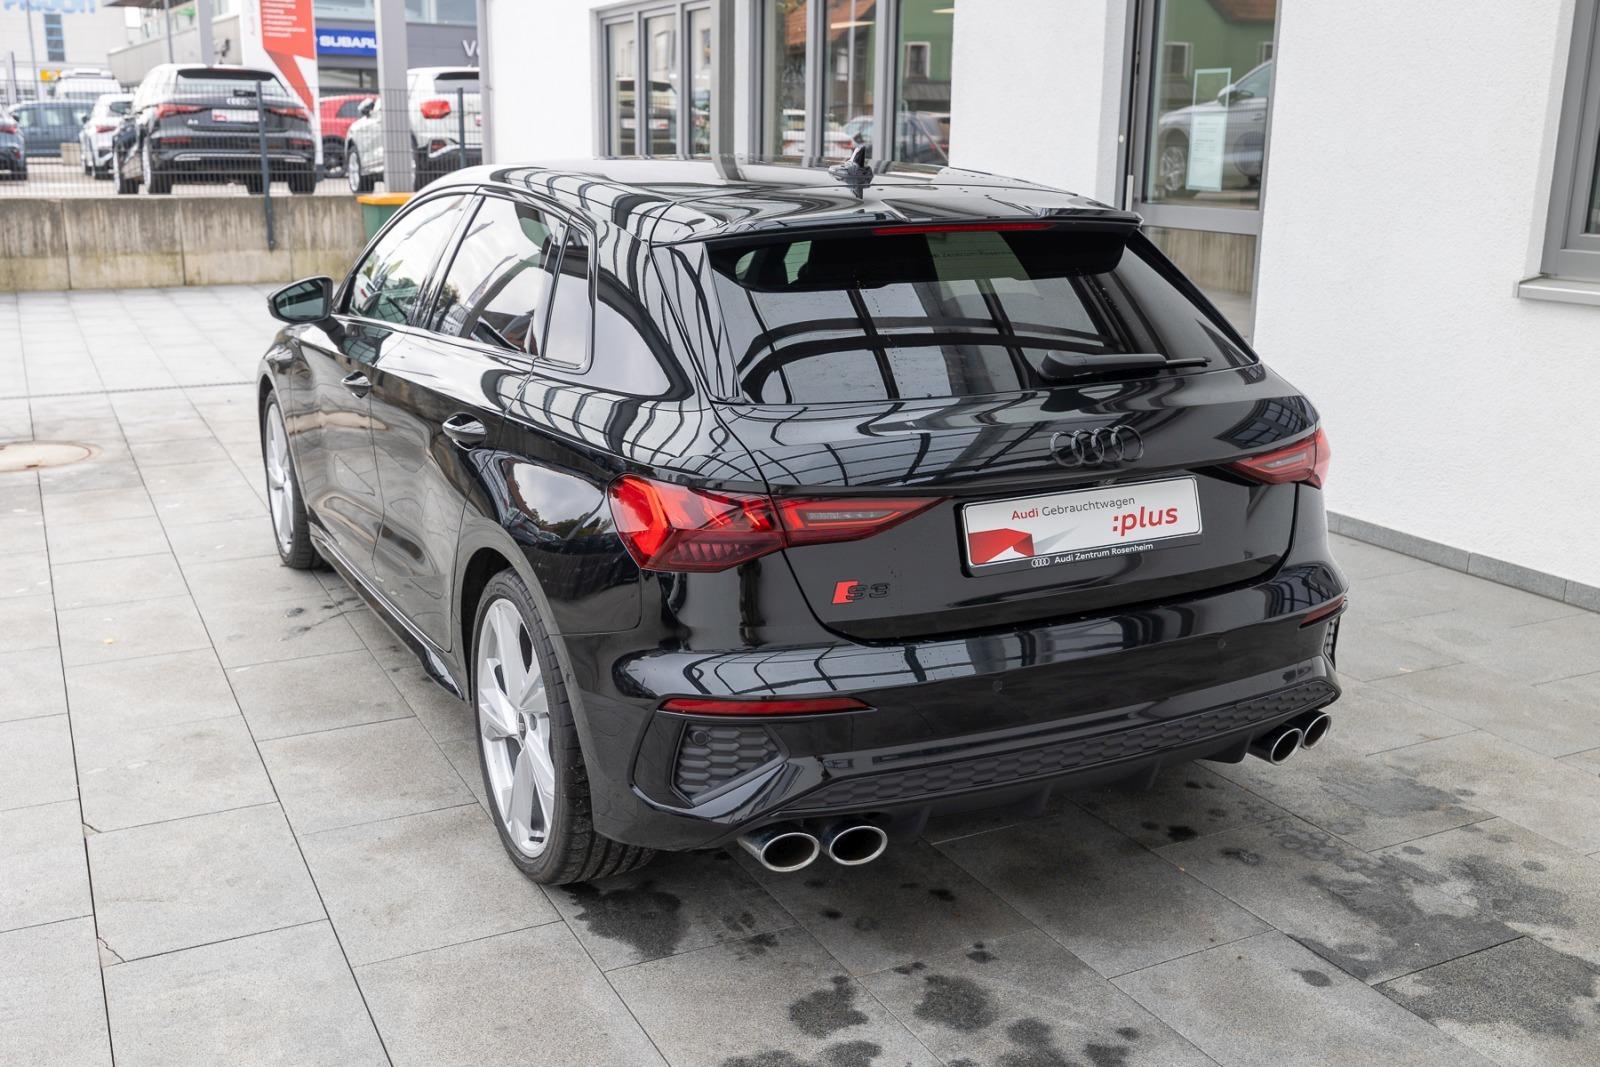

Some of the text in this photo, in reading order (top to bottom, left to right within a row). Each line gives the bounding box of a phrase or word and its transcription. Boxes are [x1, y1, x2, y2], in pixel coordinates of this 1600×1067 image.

[1011, 497, 1136, 520] Audi Gebrauchtwagen
[1054, 543, 1154, 564] Audi Zentrum Rosenheim
